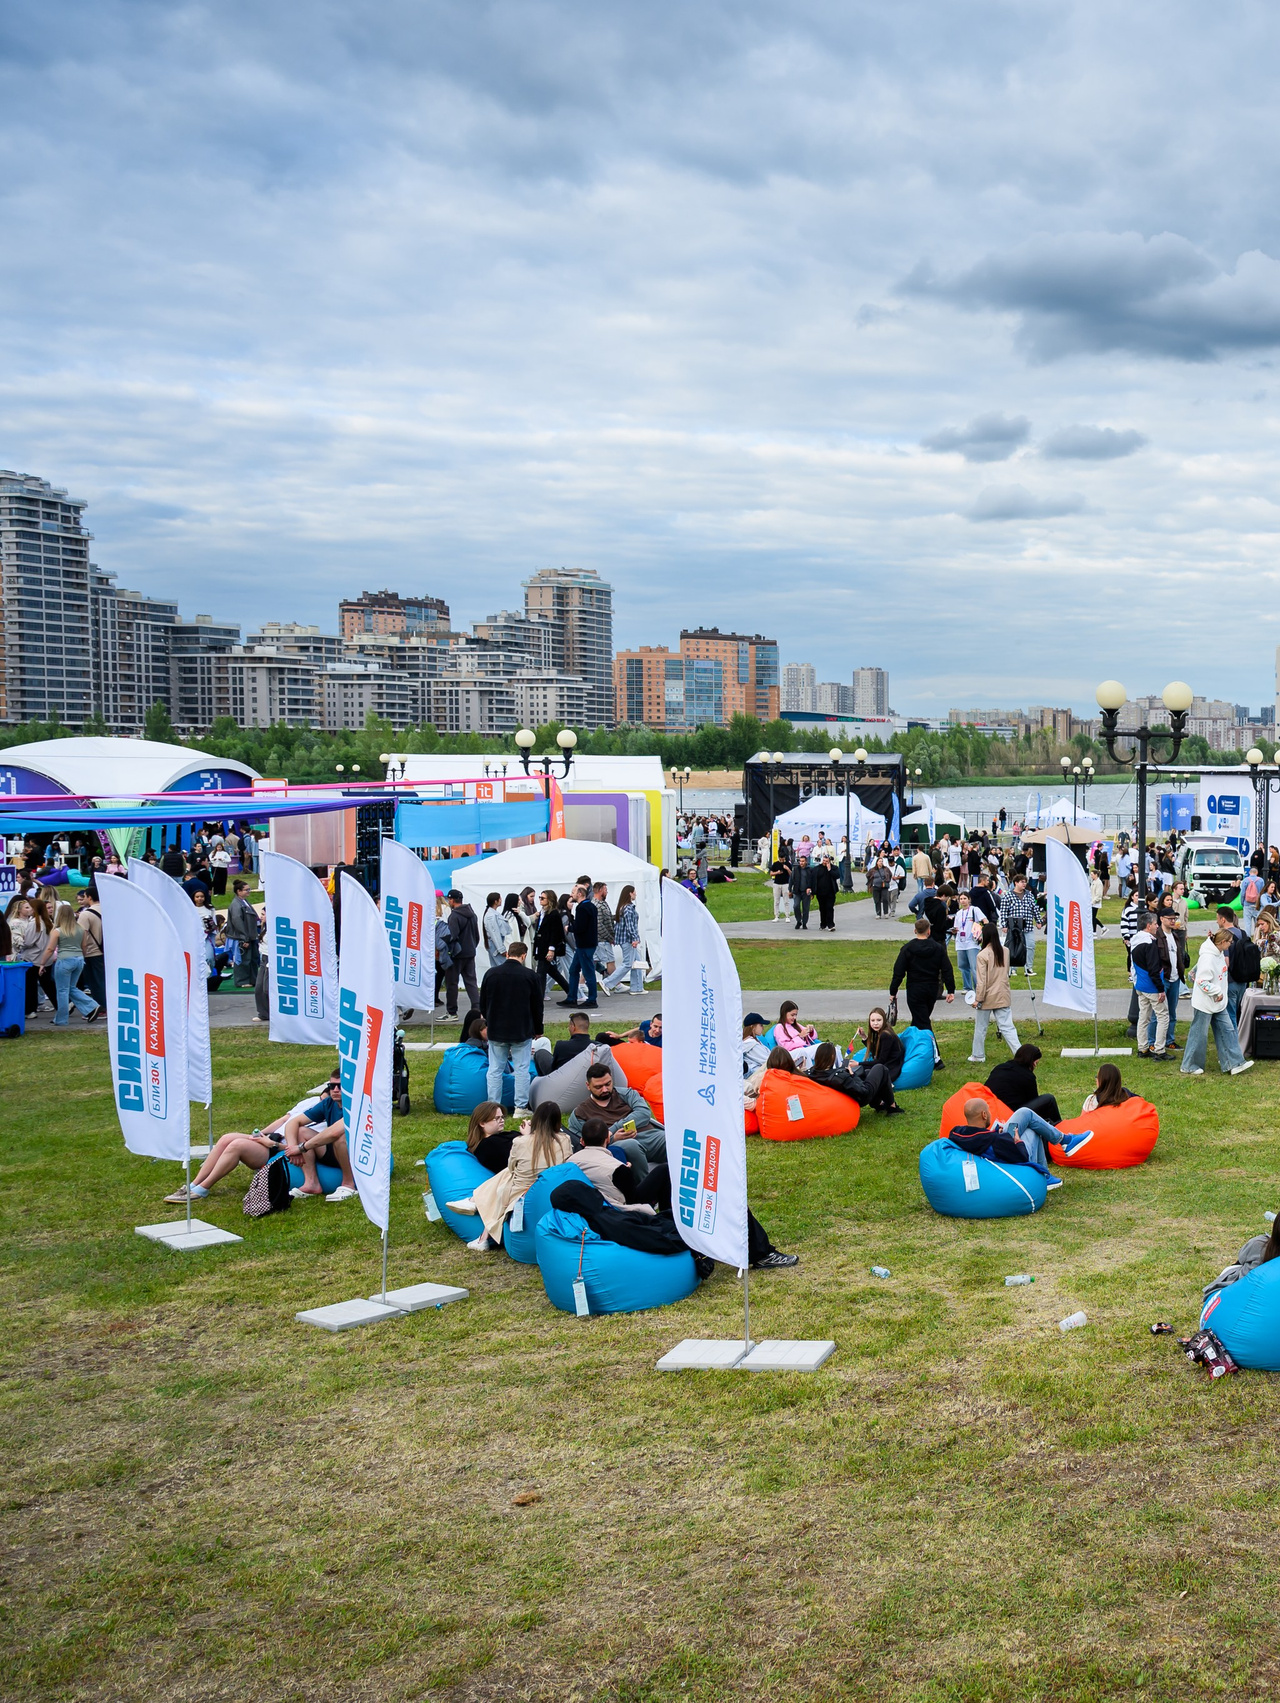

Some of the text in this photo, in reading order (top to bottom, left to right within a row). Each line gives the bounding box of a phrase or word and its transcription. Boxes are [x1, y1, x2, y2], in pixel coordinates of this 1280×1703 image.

[309, 925, 318, 972] КАЖДОМУ
[410, 906, 418, 946] КАЖДОМУ
[1054, 894, 1067, 981] СИБУР
[1072, 905, 1080, 947] КАЖДОМУ
[276, 916, 298, 1015] СИБУР
[118, 968, 144, 1112] СИБУР
[149, 980, 160, 1050] КАЖДОМУ
[679, 1128, 701, 1228] СИБУР
[707, 1140, 717, 1188] КАЖДОМУ
